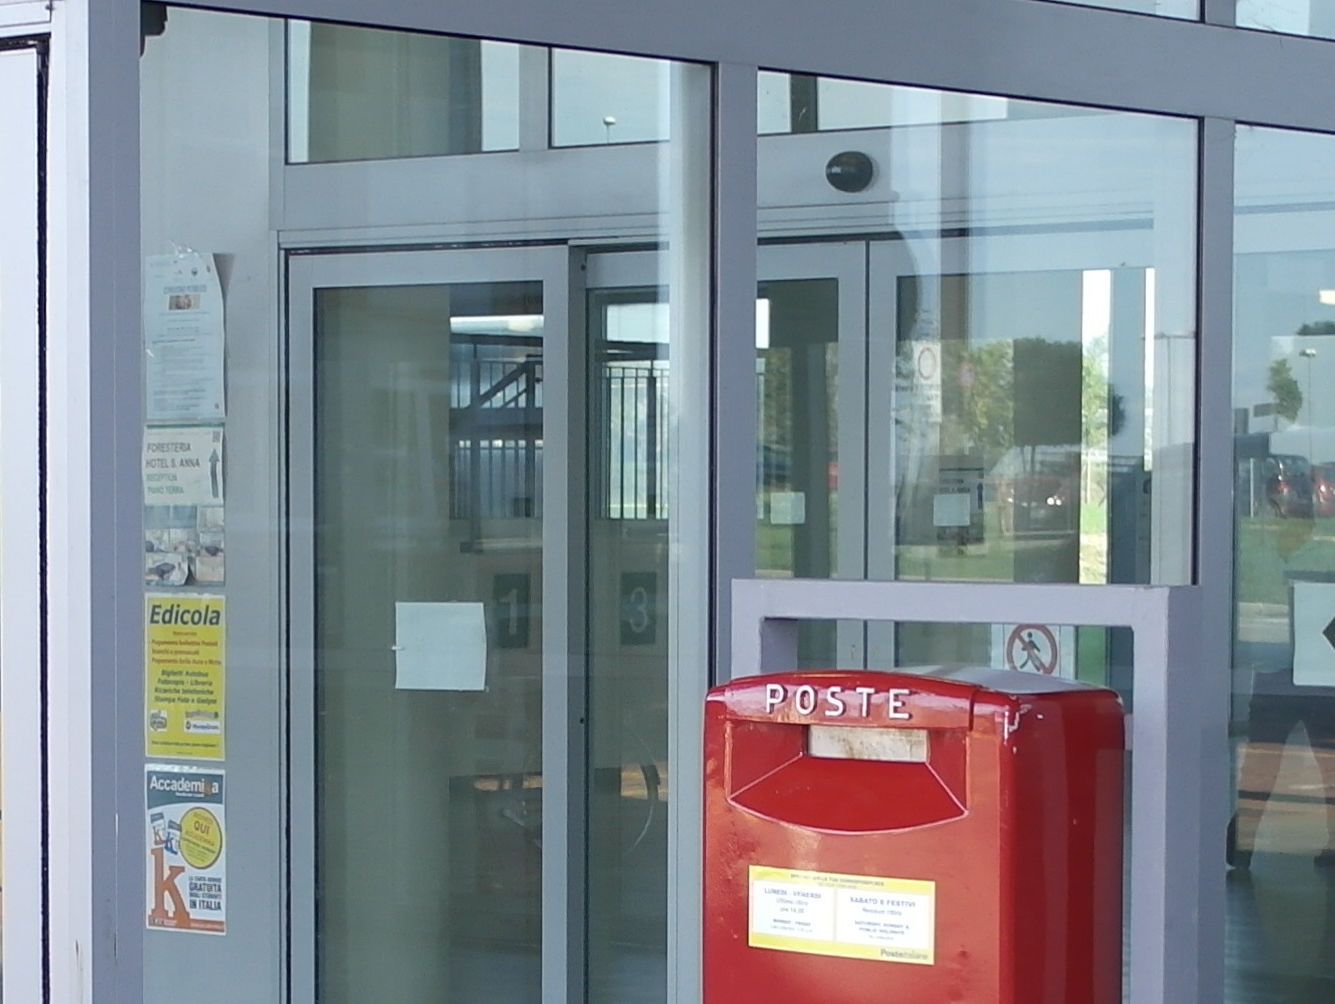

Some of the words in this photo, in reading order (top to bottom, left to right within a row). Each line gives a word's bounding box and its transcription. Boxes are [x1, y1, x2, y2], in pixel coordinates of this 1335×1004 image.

[147, 442, 191, 453] FORESTERIA
[145, 458, 169, 468] HOTEL
[179, 458, 201, 468] ANNA
[150, 603, 221, 626] Edicola
[630, 586, 648, 634] 3
[766, 683, 911, 720] POSTE
[193, 820, 210, 835] QUI
[189, 882, 222, 892] GRATUITA
[189, 899, 197, 909] IN
[199, 899, 222, 911] ITALIA
[850, 896, 878, 905] SABATO
